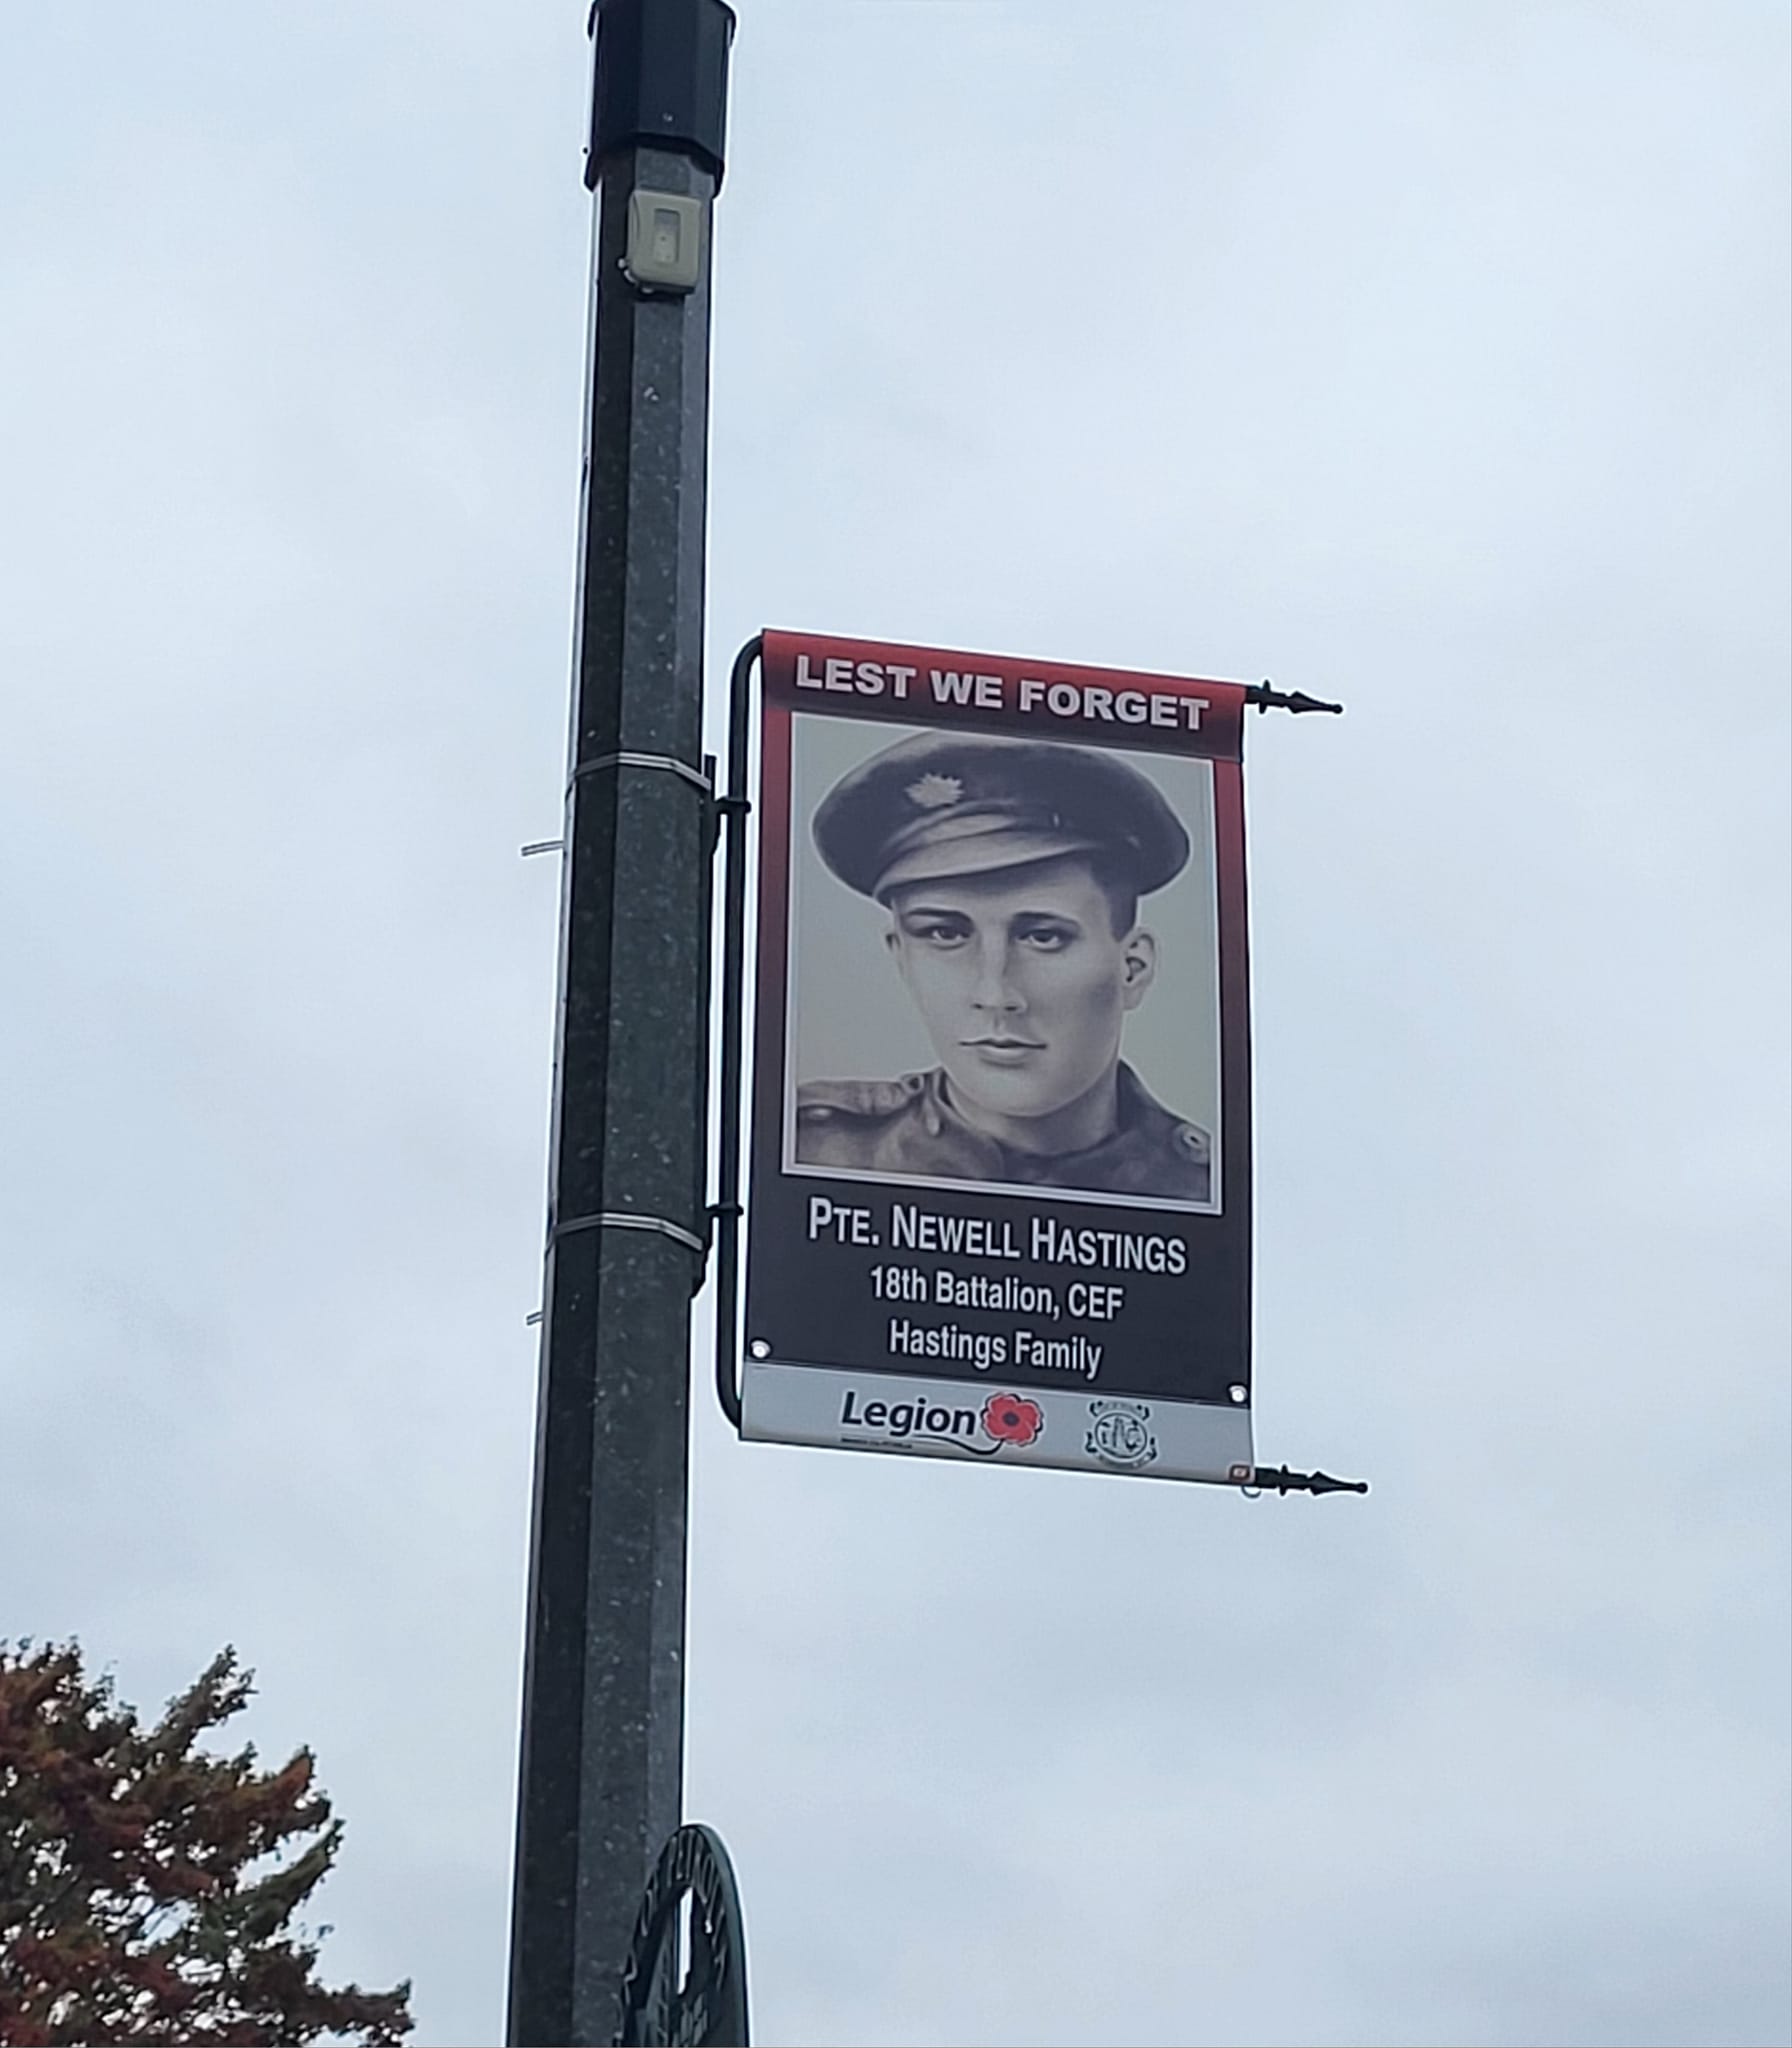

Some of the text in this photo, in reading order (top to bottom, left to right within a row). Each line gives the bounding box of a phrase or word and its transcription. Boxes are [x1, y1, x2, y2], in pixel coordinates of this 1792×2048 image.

[796, 654, 1210, 731] LEST WE FORGET
[809, 1197, 1187, 1275] PTE. NEWELL HASTINGS
[870, 1265, 1124, 1321] 18th Battalion, CEF
[889, 1319, 1102, 1380] Hastings Family
[841, 1391, 977, 1437] Legion
